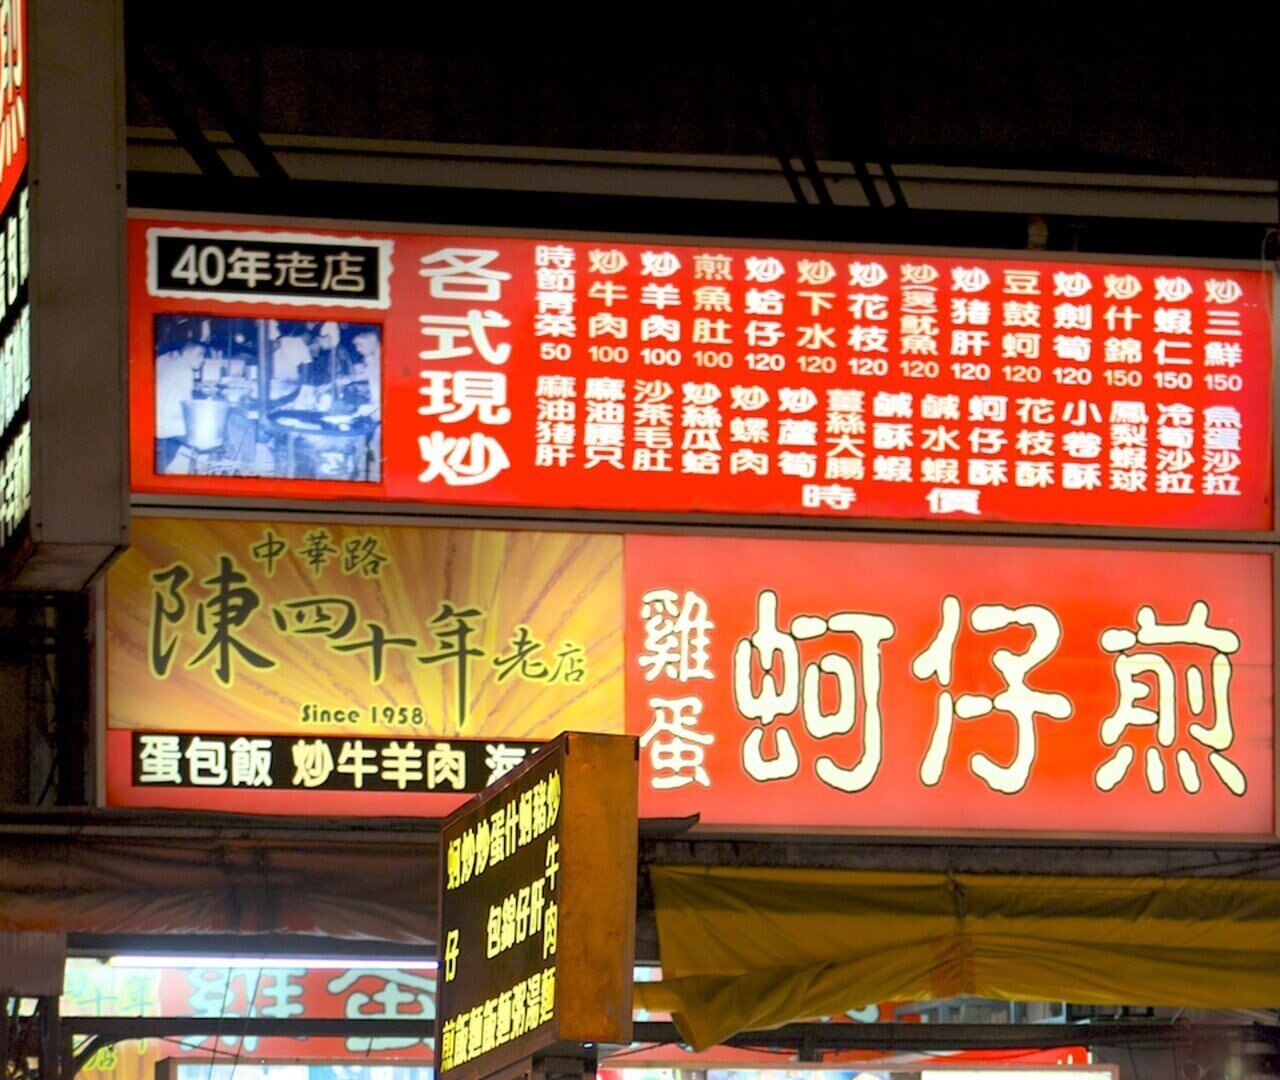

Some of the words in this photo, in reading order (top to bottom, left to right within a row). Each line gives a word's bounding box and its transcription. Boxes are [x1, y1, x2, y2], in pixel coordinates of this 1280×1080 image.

[171, 245, 366, 292] 40年老店
[417, 246, 512, 487] 各式現炒
[1015, 397, 1055, 488] 花枝酥
[1109, 401, 1148, 492] 鳳梨蝦球
[252, 532, 388, 576] 中華路
[301, 703, 361, 724] Since
[371, 704, 424, 726] 1958
[639, 588, 716, 790] 雞蛋
[734, 588, 1248, 796] 蚵仔煎
[139, 735, 273, 788] 蛋包飯
[292, 739, 467, 790] 炒牛羊肉
